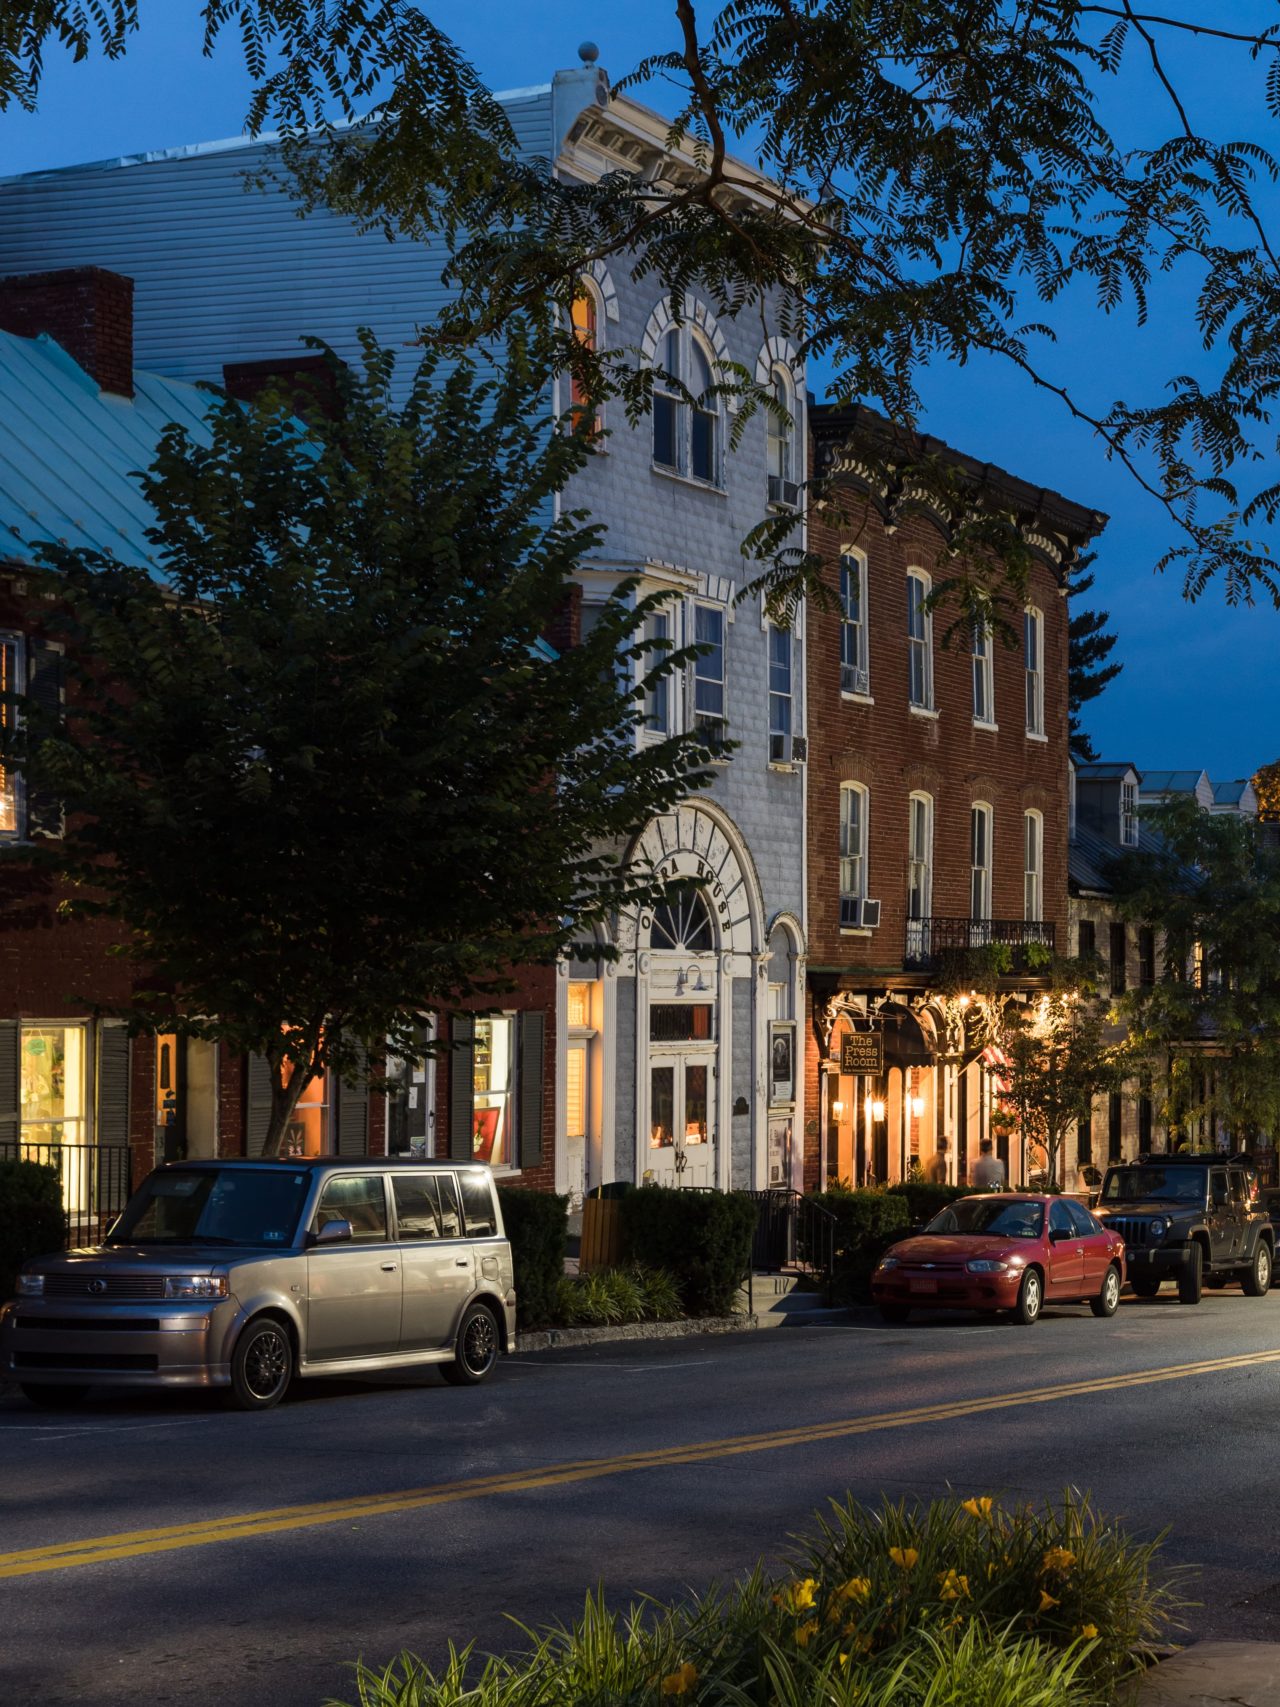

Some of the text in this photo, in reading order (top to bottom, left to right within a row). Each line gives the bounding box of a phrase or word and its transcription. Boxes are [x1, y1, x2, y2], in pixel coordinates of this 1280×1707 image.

[641, 858, 732, 932] ORA HOUSE
[850, 1035, 873, 1046] The
[844, 1045, 878, 1057] Press
[844, 1055, 878, 1067] Room
